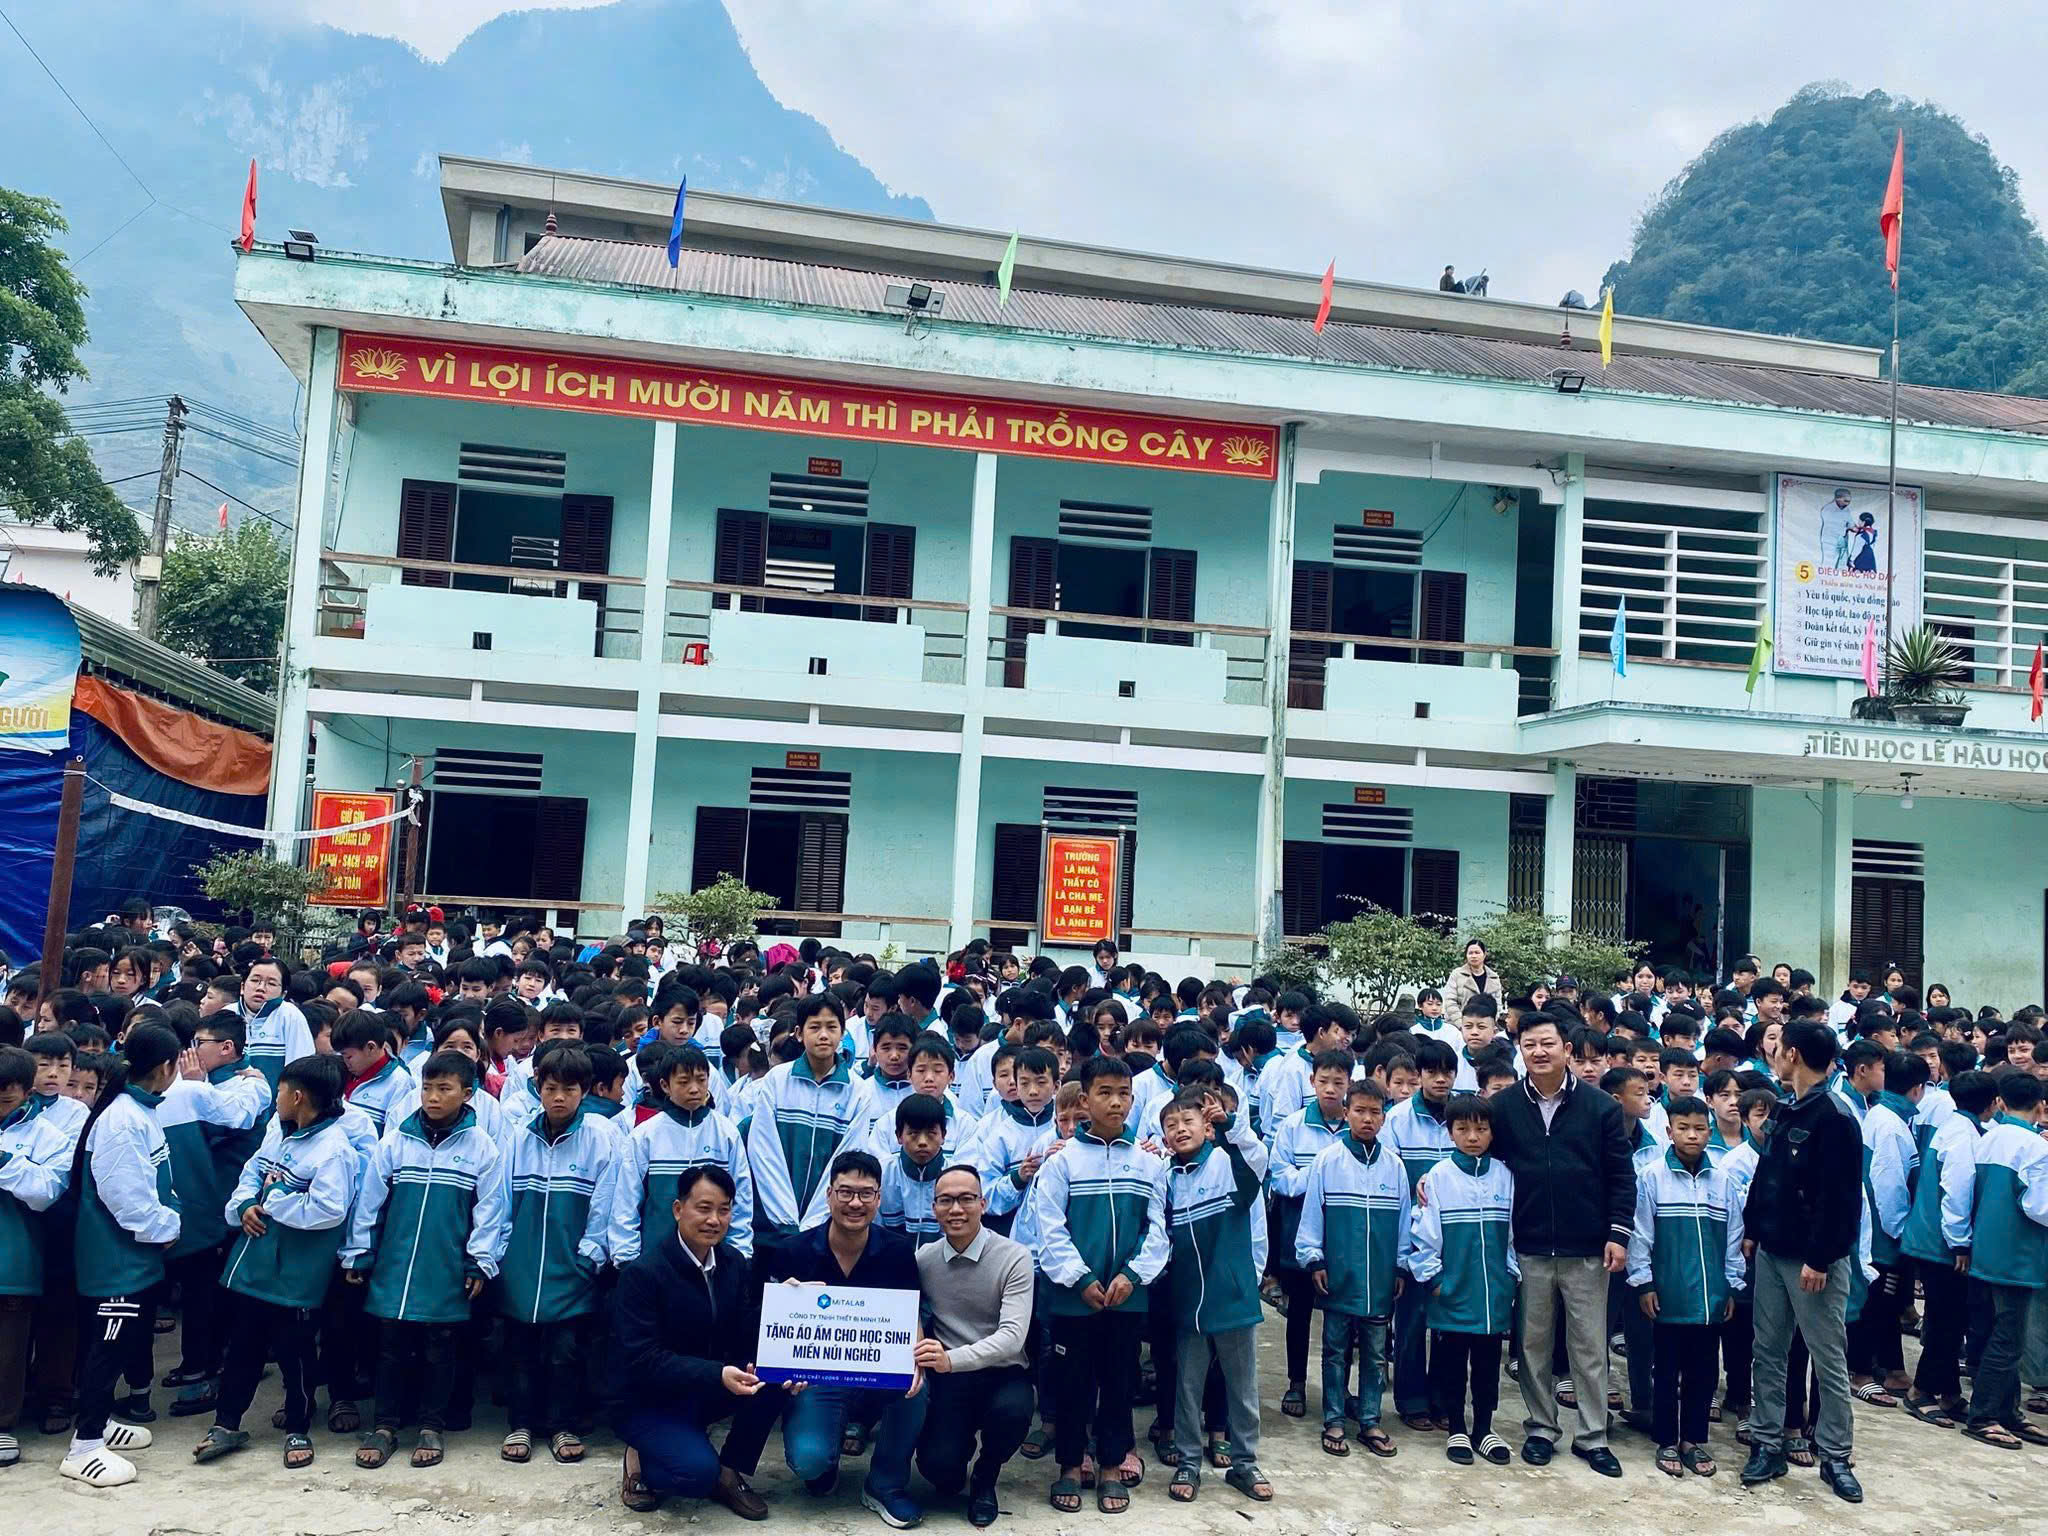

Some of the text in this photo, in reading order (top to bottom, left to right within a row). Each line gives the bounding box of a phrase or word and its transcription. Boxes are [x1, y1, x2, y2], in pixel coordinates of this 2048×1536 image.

[418, 353, 1213, 461] VÌ LỢI ÍCH MƯỜI NĂM THÌ PHẢI TRỒNG CÂY
[1800, 565, 1808, 579] 5
[1805, 589, 1820, 599] Yêu
[1805, 606, 1819, 617] Học
[1822, 607, 1833, 619] tập
[1865, 739, 1915, 763] HỌC
[1954, 743, 2002, 768] HẬU
[1065, 851, 1100, 862] TRƯỜNG
[1064, 864, 1075, 874] LÀ
[1055, 890, 1066, 900] LÀ
[1068, 891, 1086, 901] CHA
[1063, 904, 1082, 915] BẠN
[1055, 916, 1104, 928] LÀ ANH EM
[766, 1322, 911, 1345] TẶNG ÁO ẤM CHO HỌC SINH
[822, 1344, 842, 1361] NÚI
[844, 1346, 881, 1362] NGHÈO
